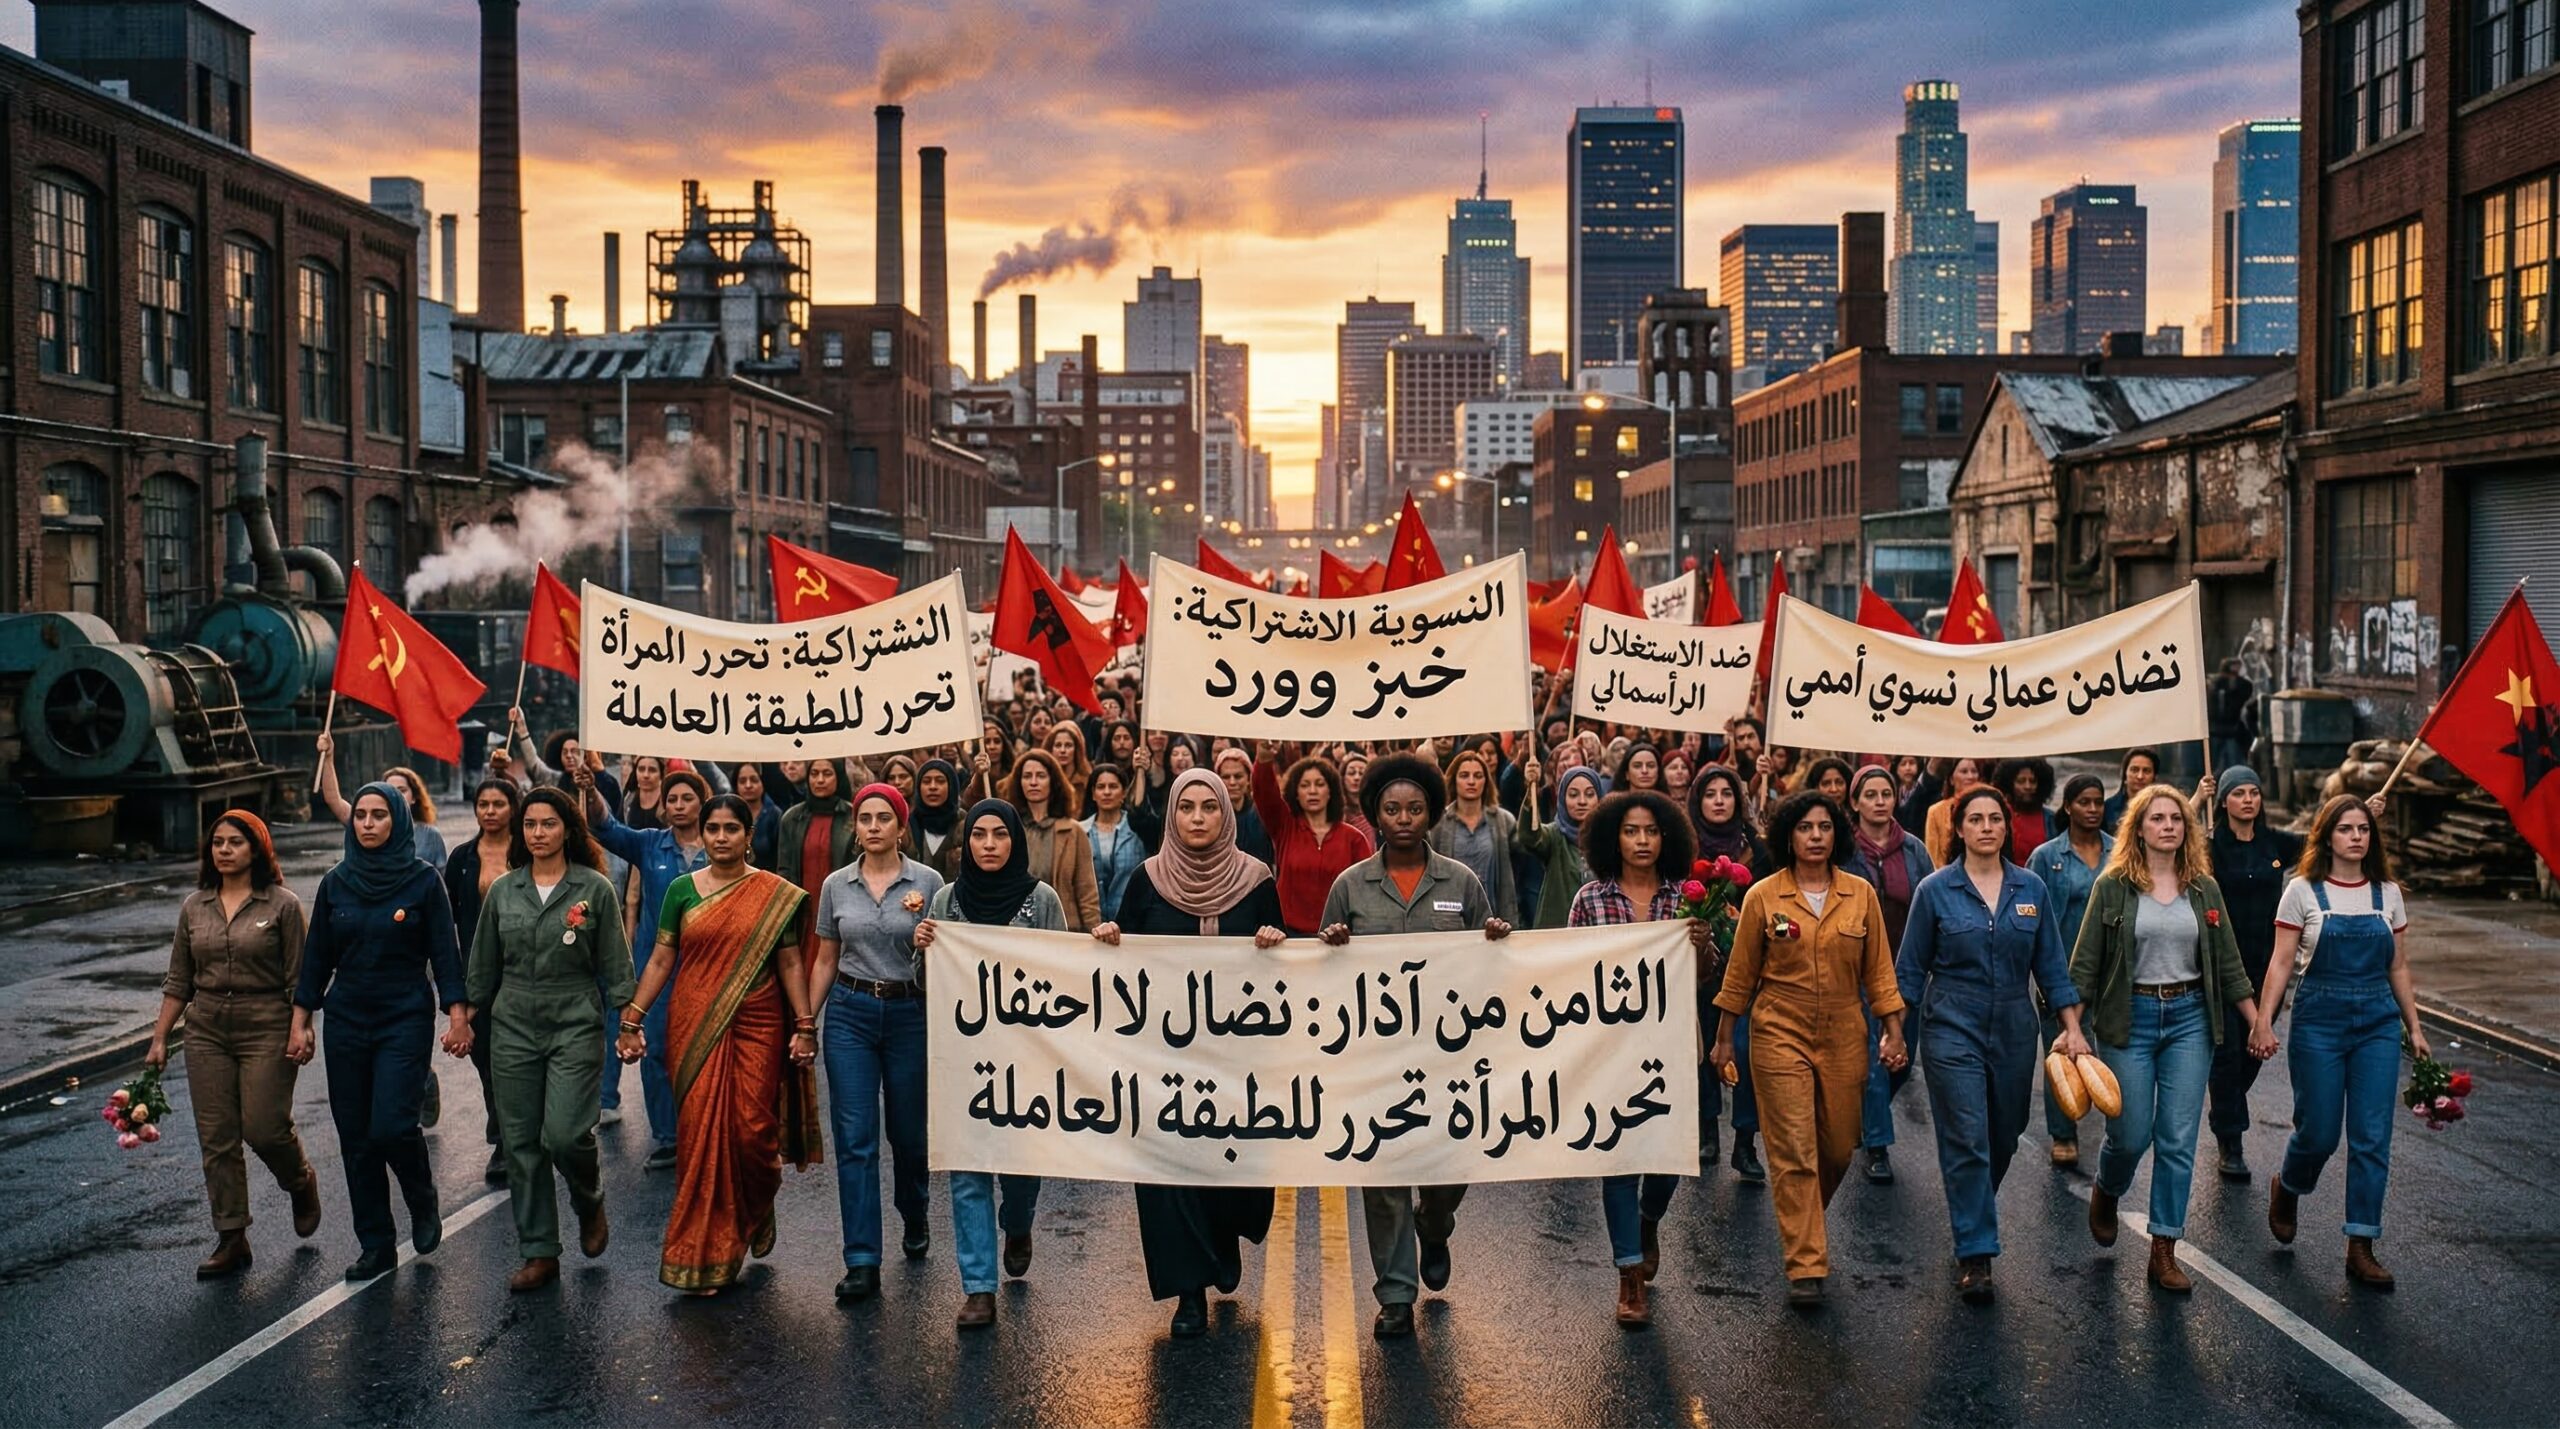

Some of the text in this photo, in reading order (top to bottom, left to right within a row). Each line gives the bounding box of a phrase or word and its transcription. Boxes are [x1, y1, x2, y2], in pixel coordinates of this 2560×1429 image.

[601, 608, 686, 671] المرأة
[1174, 580, 1504, 648] النسوية الاشتراكية:
[1589, 623, 1752, 669] ضد الاستغلال
[692, 637, 770, 680] تحرر
[1205, 645, 1467, 720] خبز وورد
[1591, 670, 1706, 716] الرأسمالي
[1785, 643, 2181, 734] تضامن عمالي نسوي أممي
[606, 671, 956, 749] تحرر للطبقة العاملة
[954, 957, 1667, 1056] الثامن من آذار: نضال لا احتفال
[968, 1057, 1672, 1164] تحرر المرأة تحرر للطبقة العاملة
